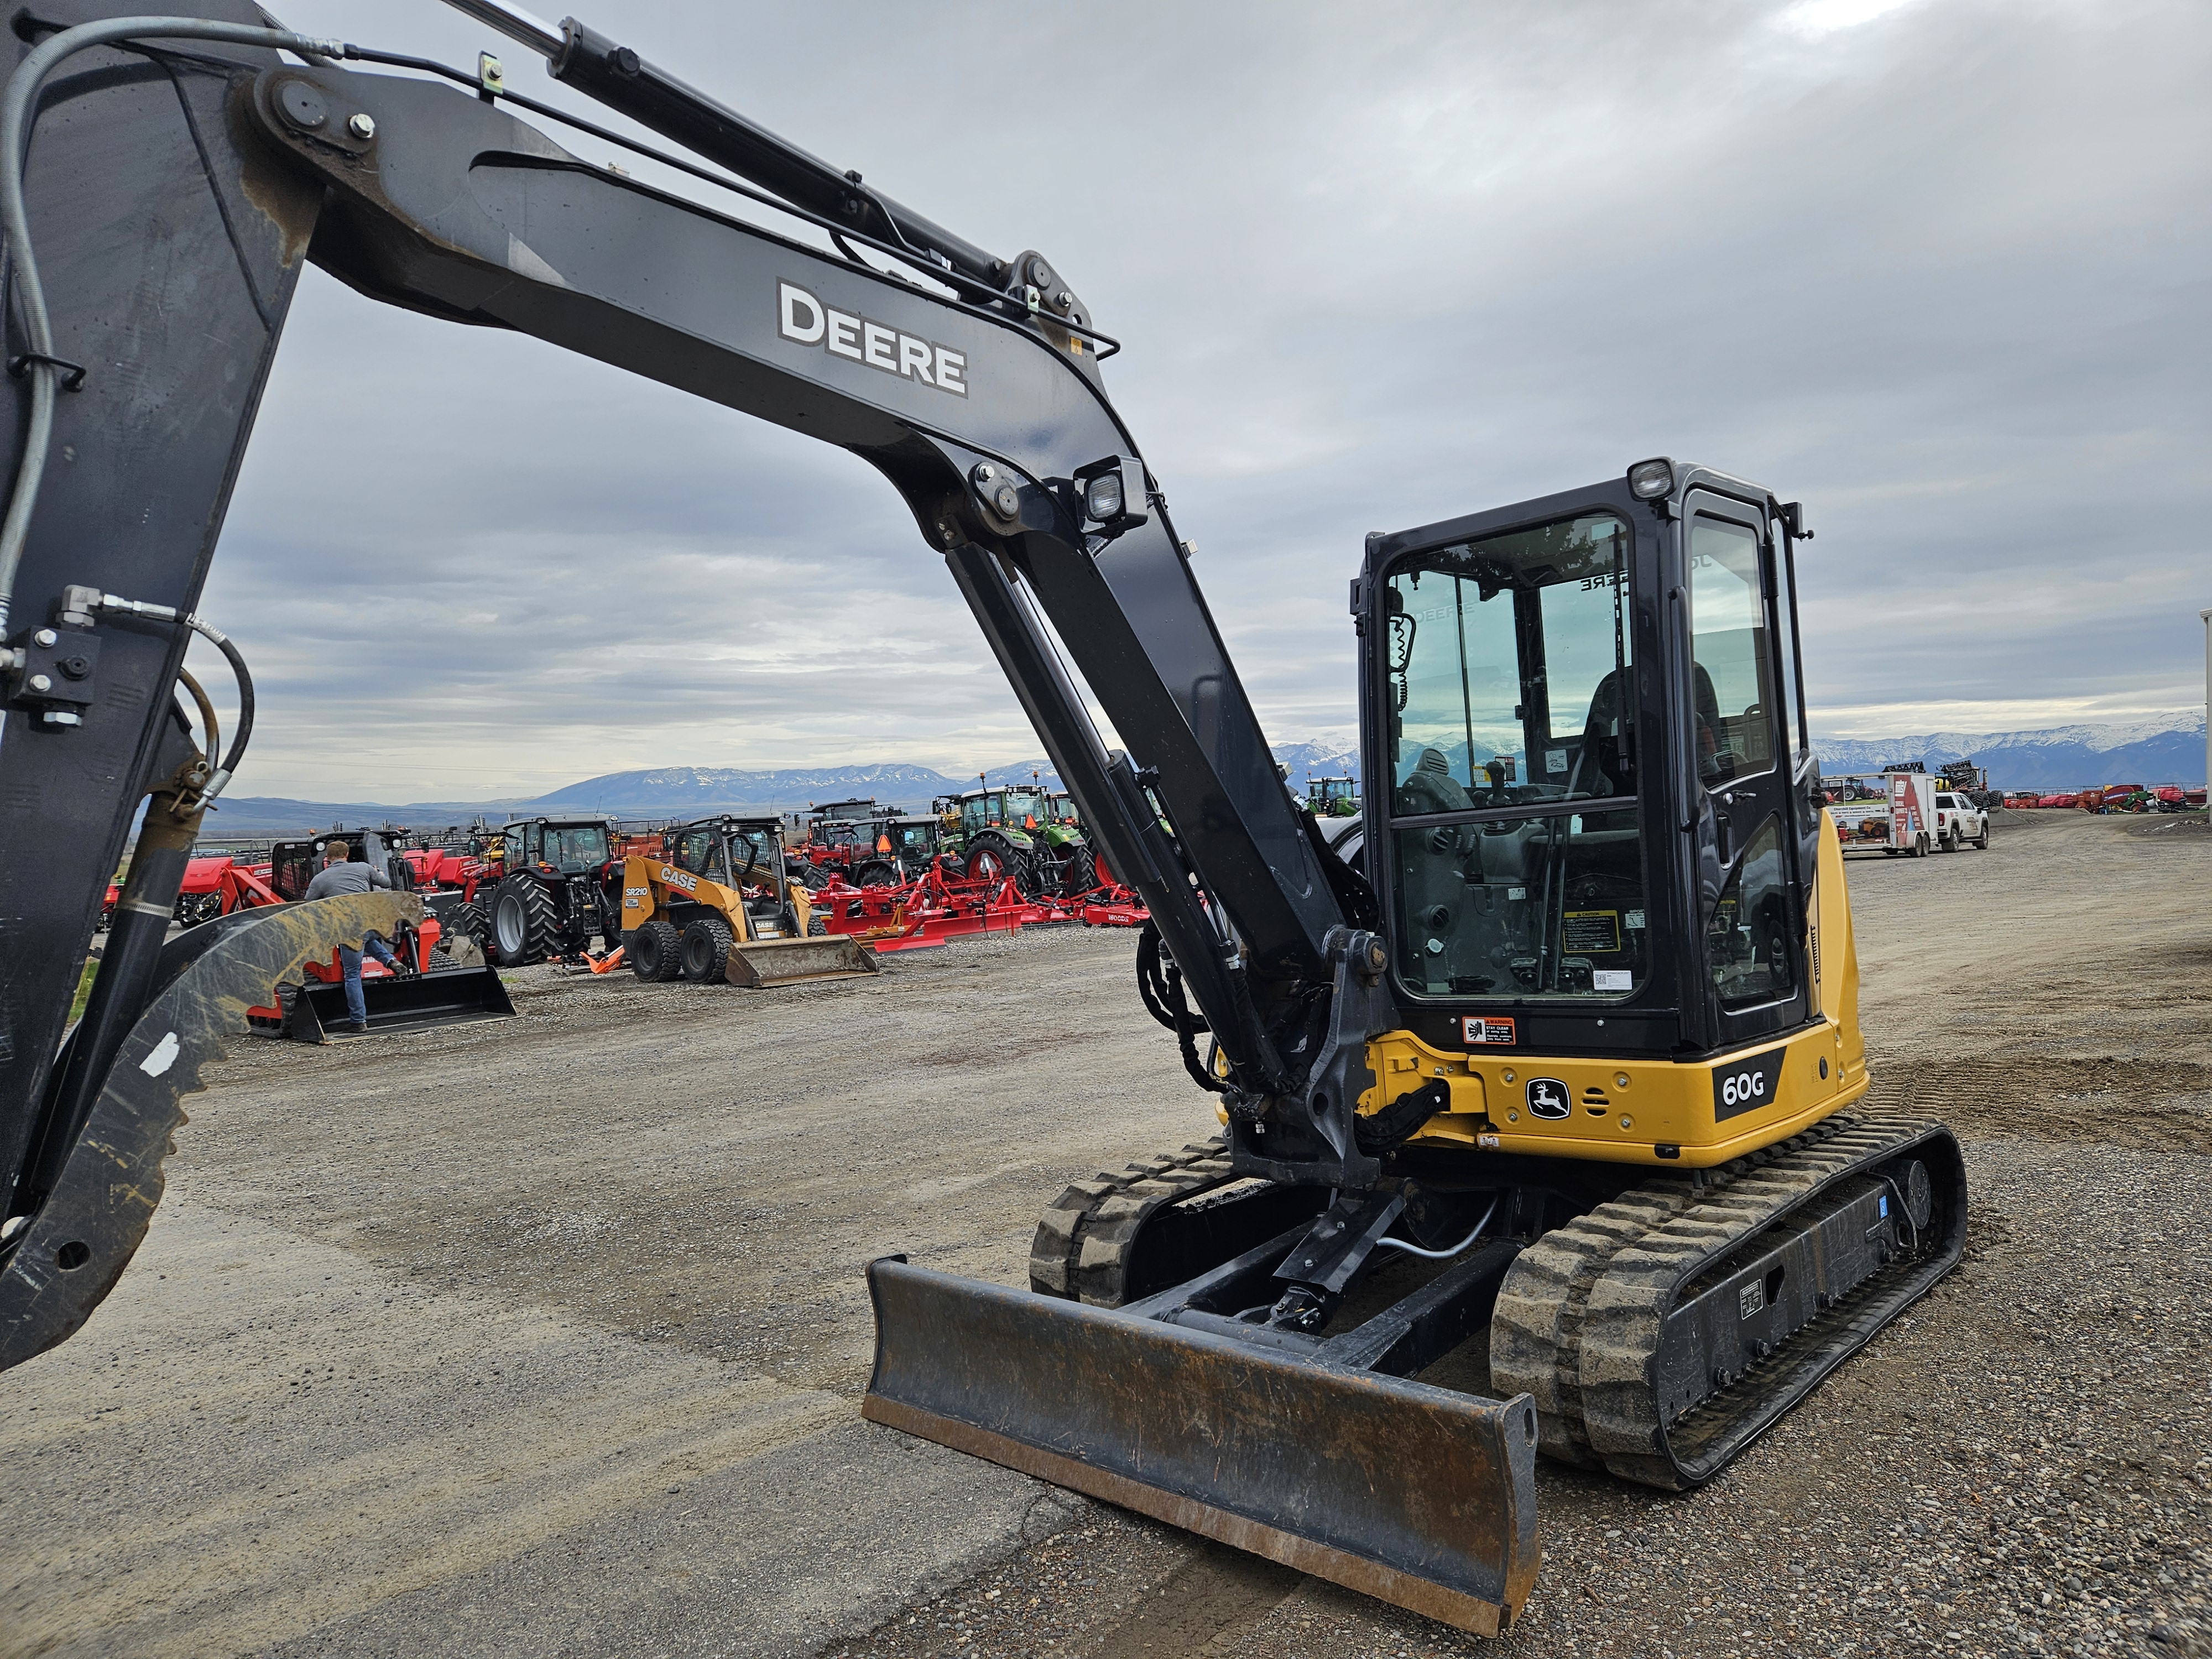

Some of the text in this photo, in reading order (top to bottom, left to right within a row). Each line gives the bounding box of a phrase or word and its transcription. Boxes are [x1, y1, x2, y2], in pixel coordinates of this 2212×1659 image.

[780, 282, 966, 394] DEERE
[625, 886, 648, 896] SR210
[660, 866, 698, 892] CASE
[1108, 914, 1129, 922] WOODS
[1722, 1071, 1765, 1105] 60G
